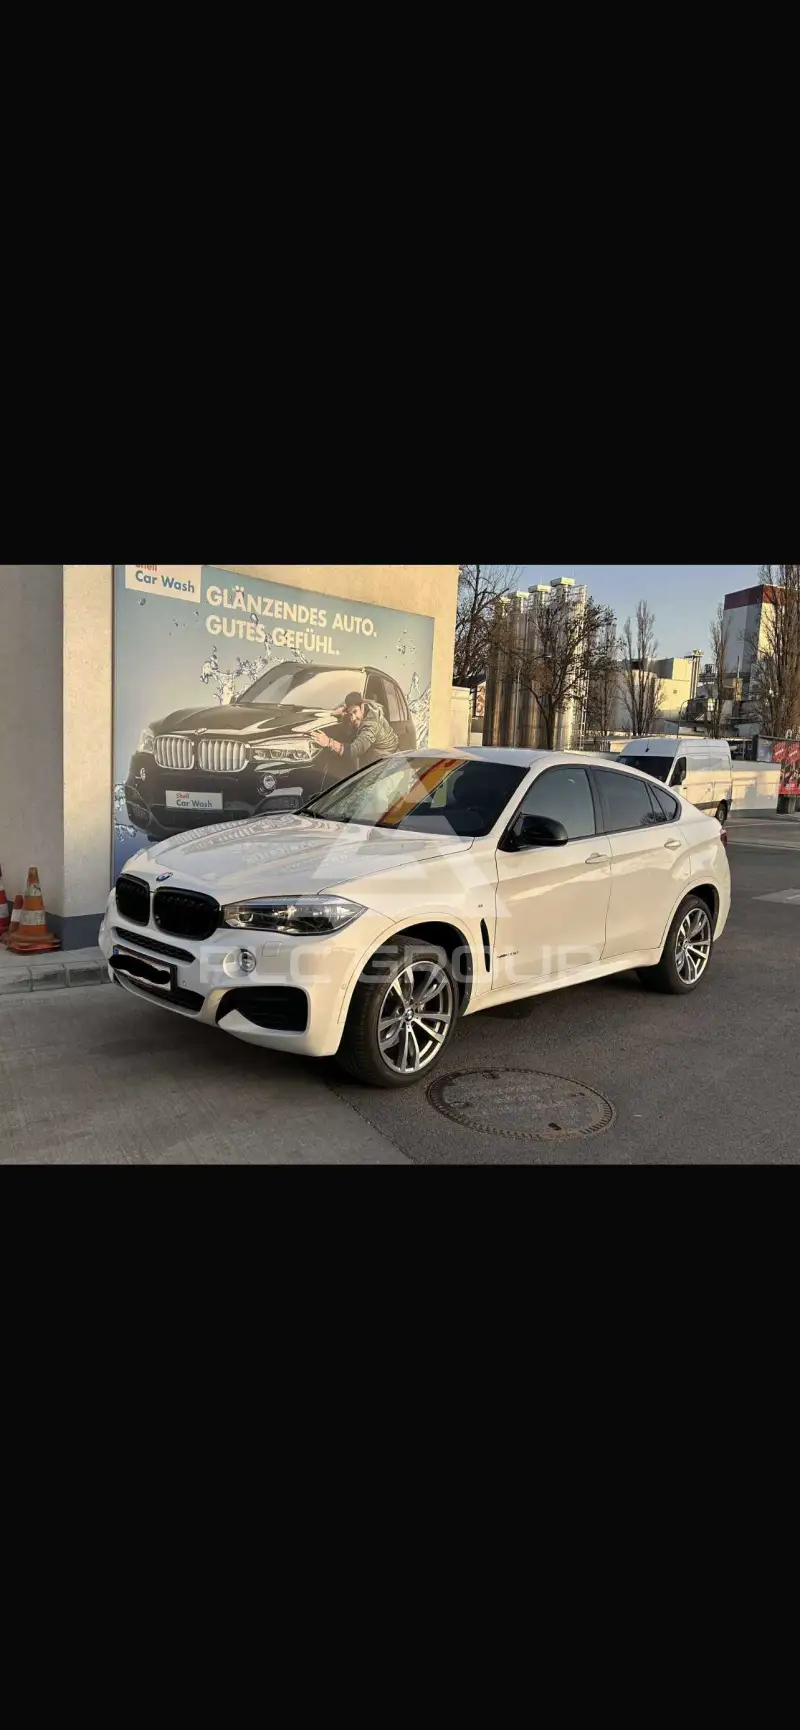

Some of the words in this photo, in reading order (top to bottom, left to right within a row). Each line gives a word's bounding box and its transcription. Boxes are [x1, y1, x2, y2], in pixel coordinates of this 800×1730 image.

[135, 570, 157, 584] Car
[161, 575, 195, 593] Wash
[206, 585, 327, 628] GLÄNZENDES
[331, 613, 377, 637] AUTO.
[205, 615, 267, 644] GUTES
[271, 627, 340, 656] GEFÜHL.
[176, 799, 190, 807] Car
[191, 800, 213, 808] Wash
